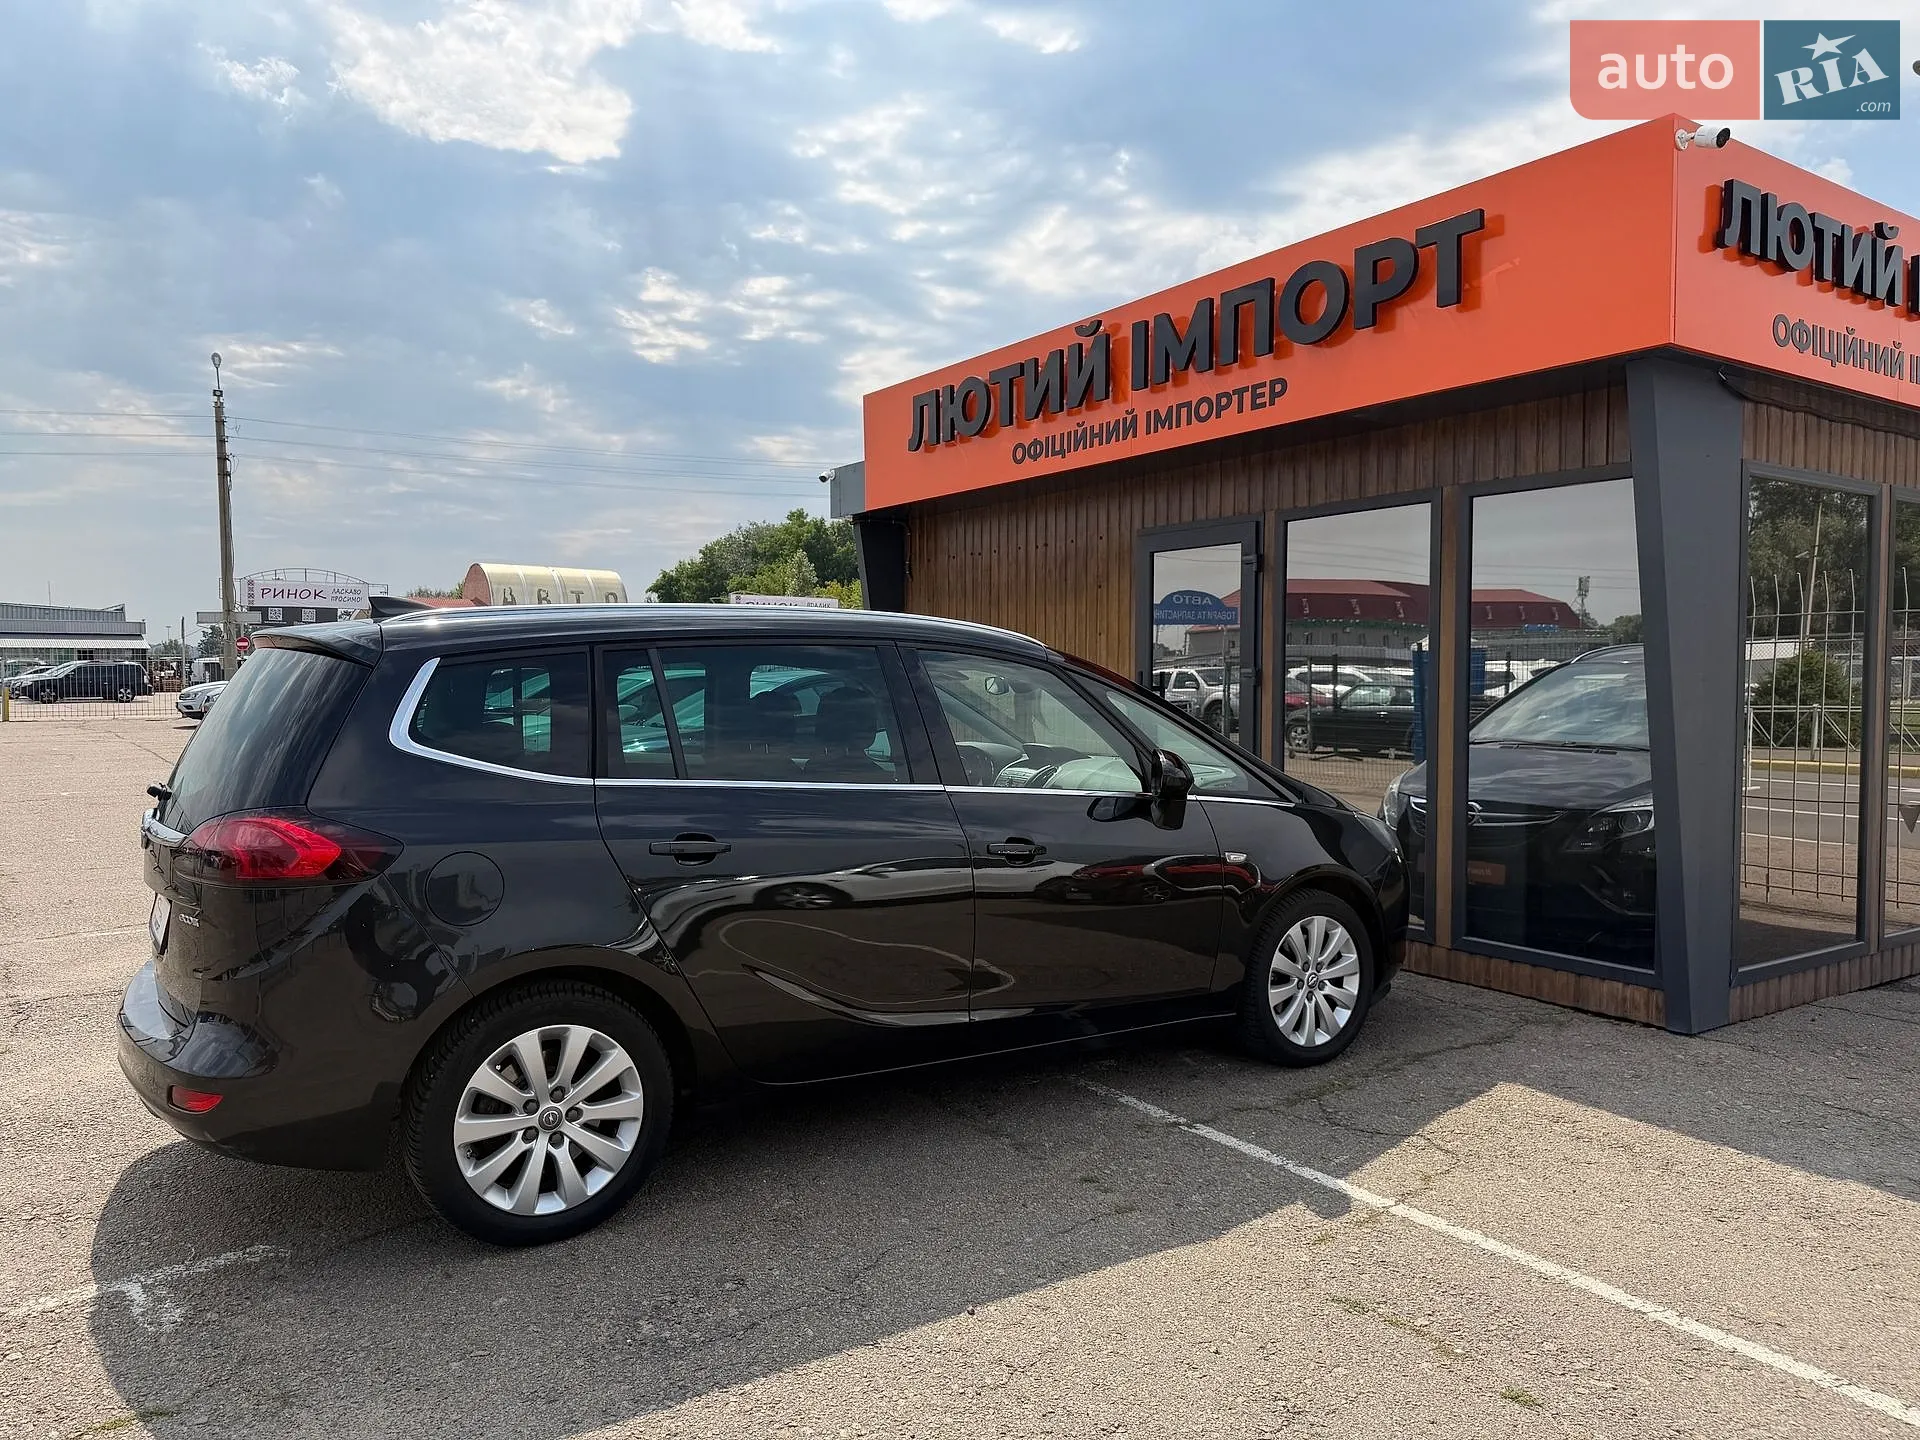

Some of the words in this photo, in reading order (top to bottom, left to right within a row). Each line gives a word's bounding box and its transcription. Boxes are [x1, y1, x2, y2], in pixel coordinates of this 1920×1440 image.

[1715, 178, 1904, 308] ЛЮТИЙ
[908, 319, 1112, 453] ЛЮТИЙ
[1130, 207, 1486, 392] ІМПОРТ
[1772, 313, 1905, 381] ОФІЦІЙНИЙ
[1011, 408, 1138, 466] ОФІЦІЙНИЙ
[1144, 376, 1289, 433] ІМПОРТЕР
[260, 587, 328, 600] РИНОК
[331, 588, 362, 596] ЛАСКАВО
